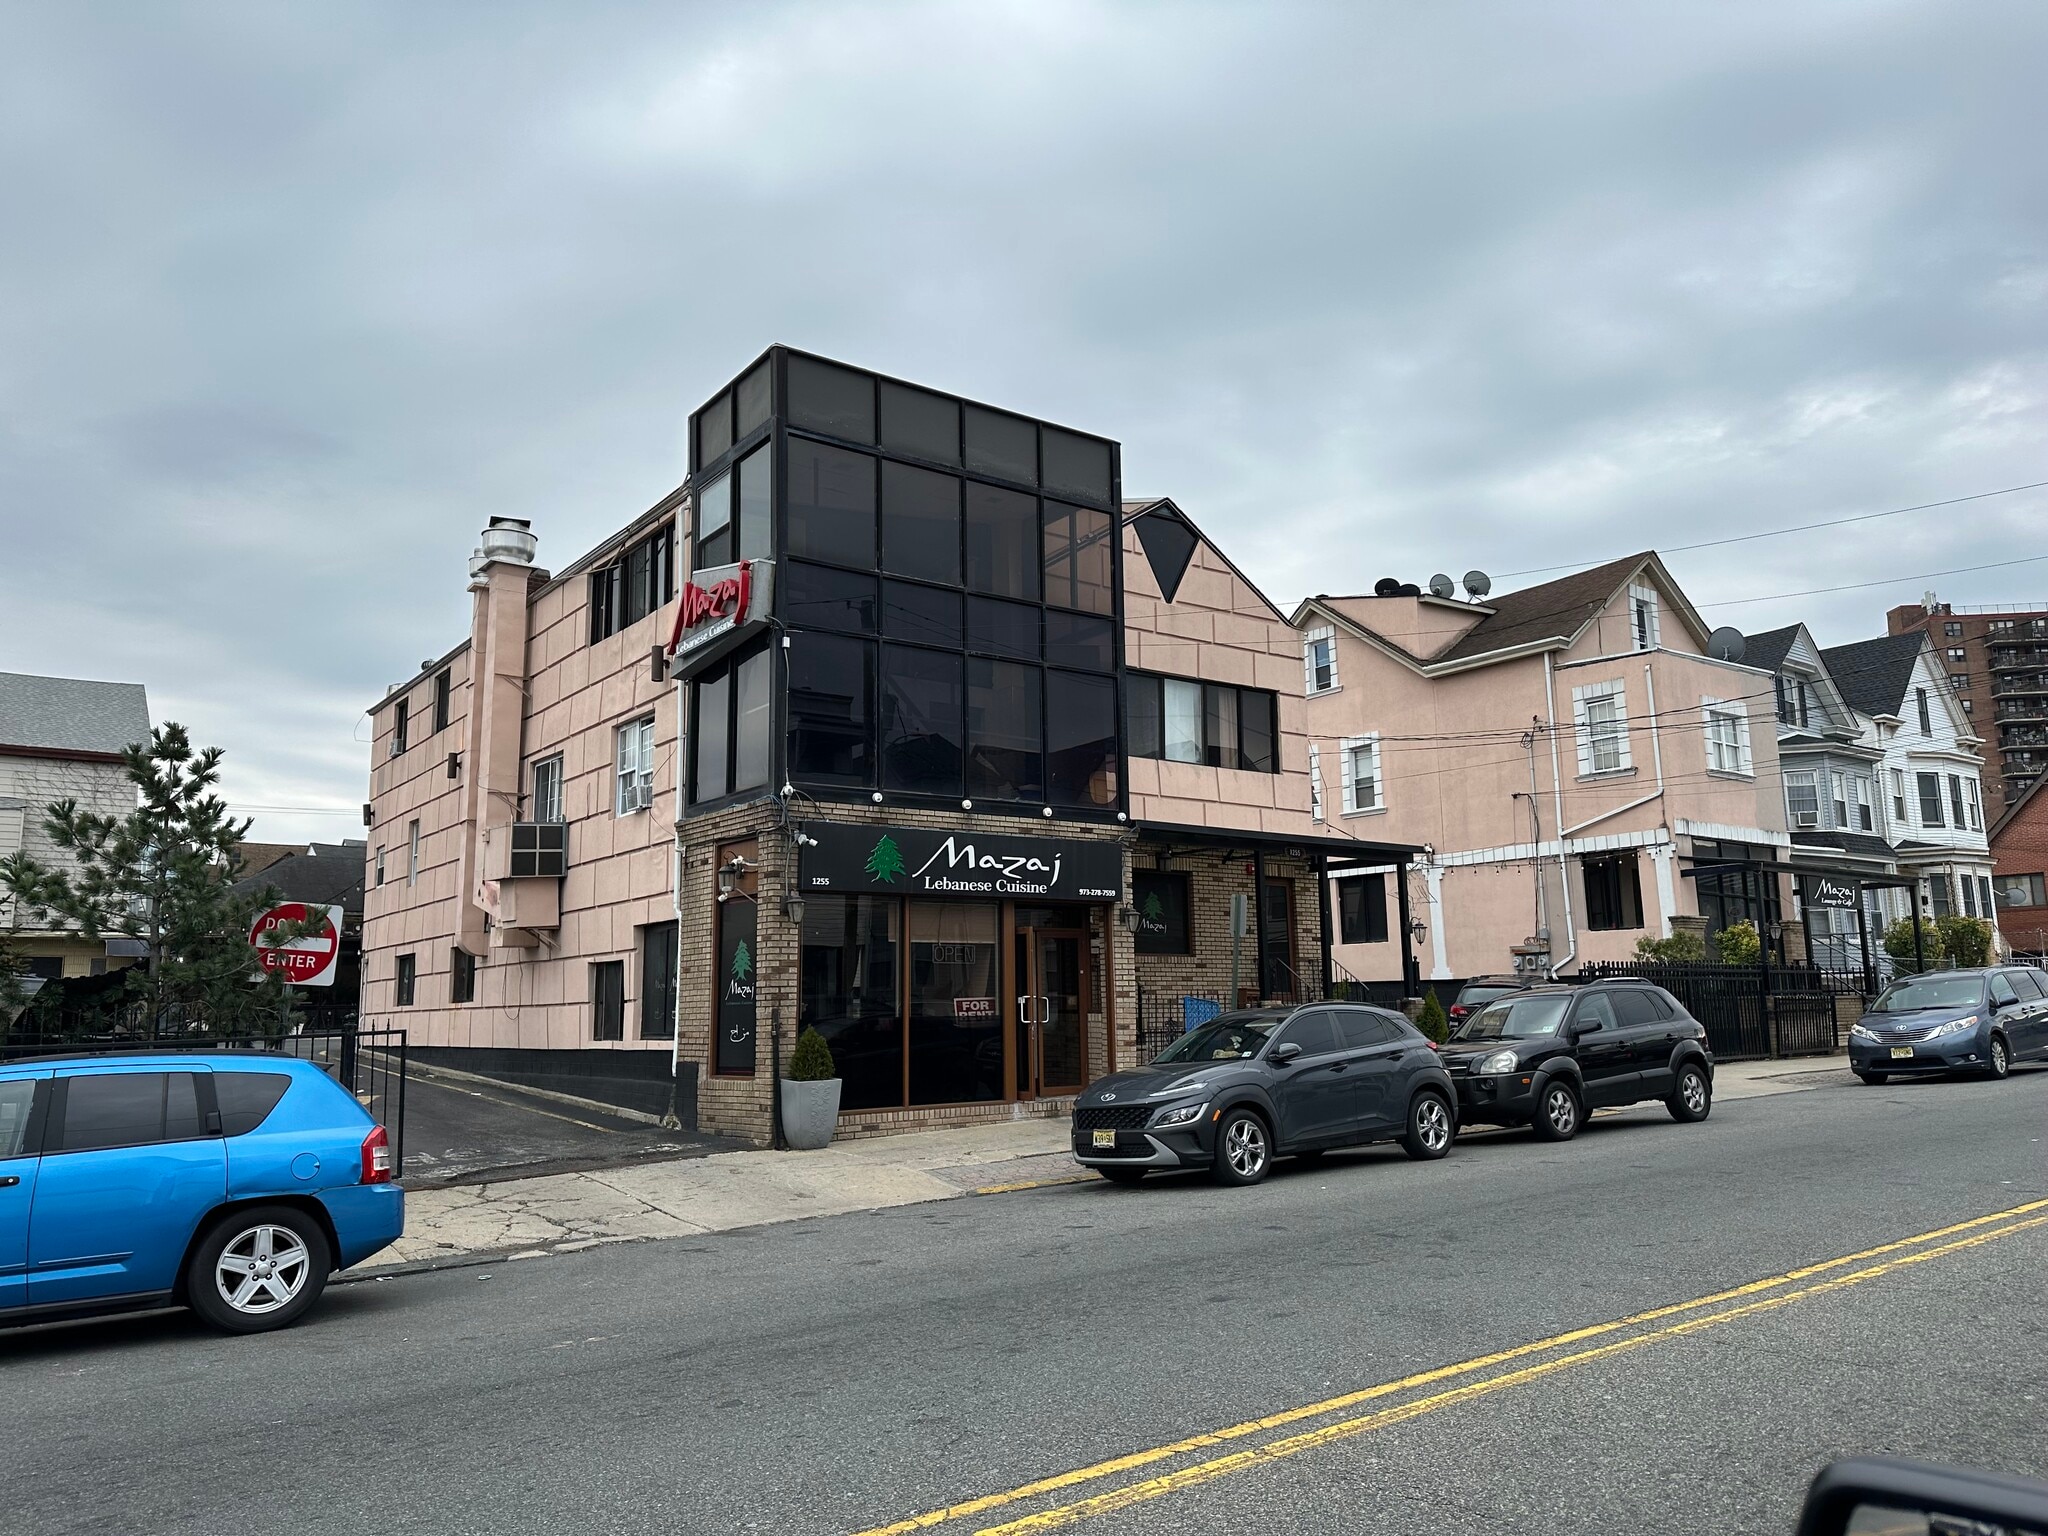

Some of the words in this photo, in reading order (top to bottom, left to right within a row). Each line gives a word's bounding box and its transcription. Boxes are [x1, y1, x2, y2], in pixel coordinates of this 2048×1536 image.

[667, 560, 752, 655] Mazaj
[676, 631, 708, 655] Lebanese
[912, 836, 1062, 887] Mazaj
[812, 877, 830, 886] 1255
[924, 876, 992, 892] Lebanese
[996, 879, 1048, 894] Cuisine
[1078, 888, 1116, 897] 973-278-7559
[1814, 878, 1856, 903] Mazaj
[1137, 917, 1167, 934] Mazaj
[266, 952, 316, 969] ENTER
[934, 945, 975, 962] OPEN
[725, 979, 755, 1001] Mazaj
[961, 1000, 990, 1011] FOR
